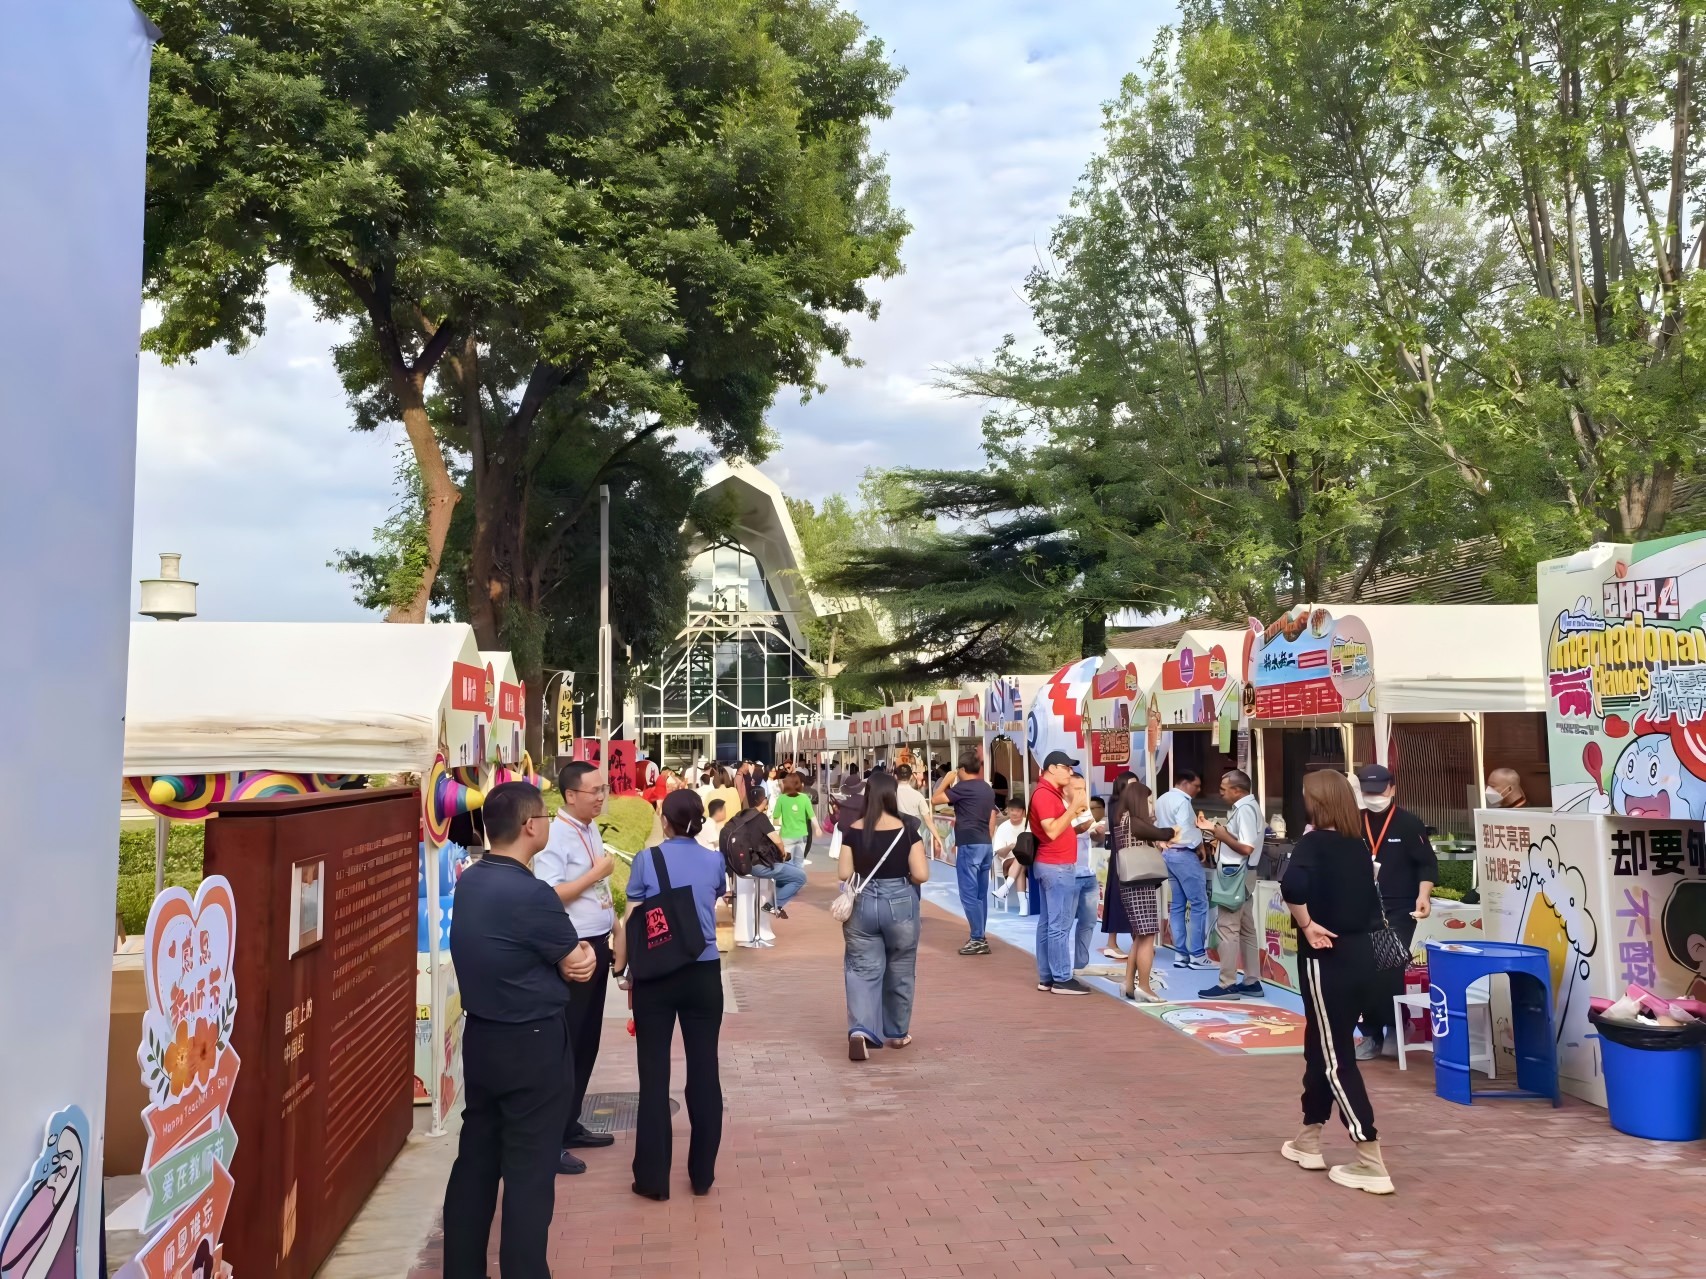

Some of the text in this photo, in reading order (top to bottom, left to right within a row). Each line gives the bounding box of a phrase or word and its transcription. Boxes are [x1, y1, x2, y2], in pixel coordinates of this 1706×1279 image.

[1604, 577, 1680, 619] 2024
[1483, 824, 1531, 852] 到天亮再
[1485, 856, 1521, 884] 说晚安
[162, 1114, 184, 1137] Happy
